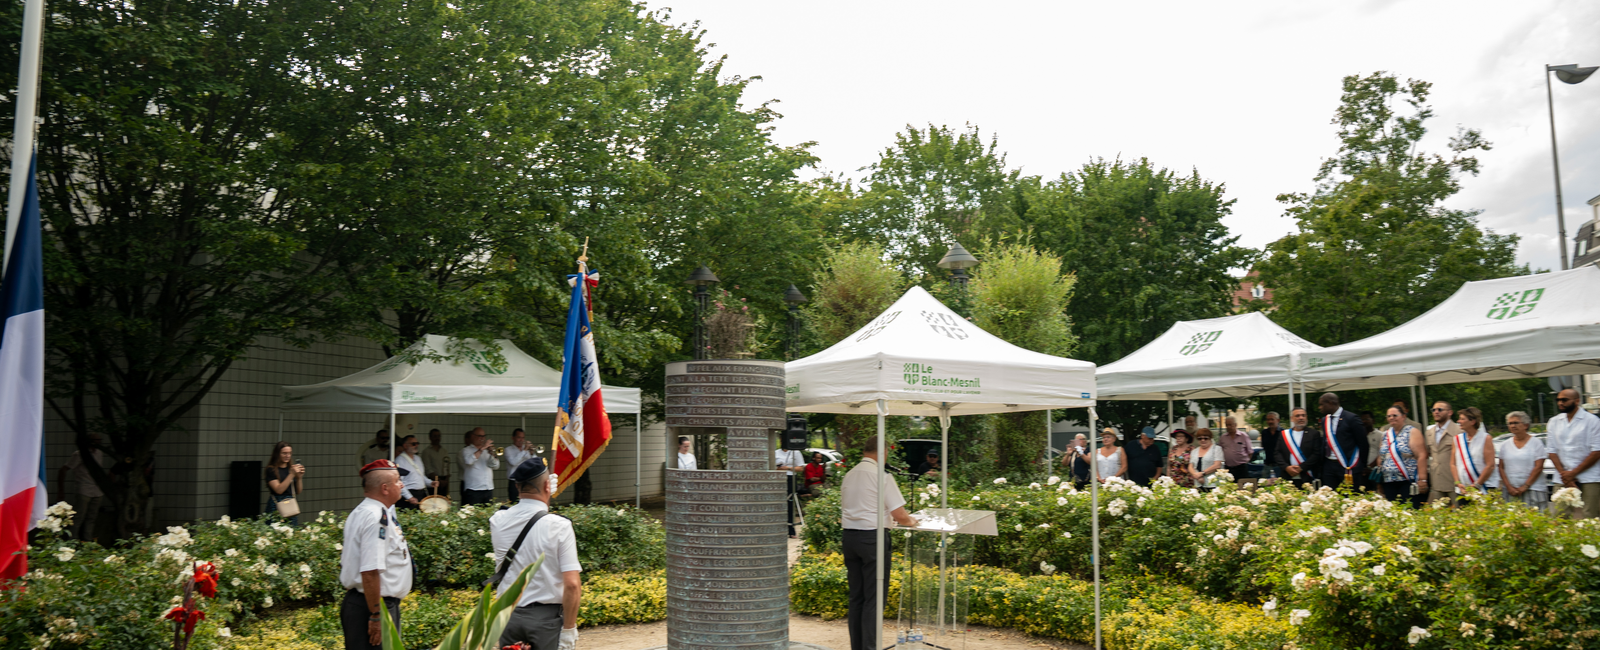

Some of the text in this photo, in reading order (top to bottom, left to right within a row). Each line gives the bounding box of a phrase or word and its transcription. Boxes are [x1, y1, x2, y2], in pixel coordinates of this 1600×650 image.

[921, 363, 933, 374] Le
[922, 375, 981, 388] Blanc-Mesnil
[700, 526, 729, 534] NOTRE
